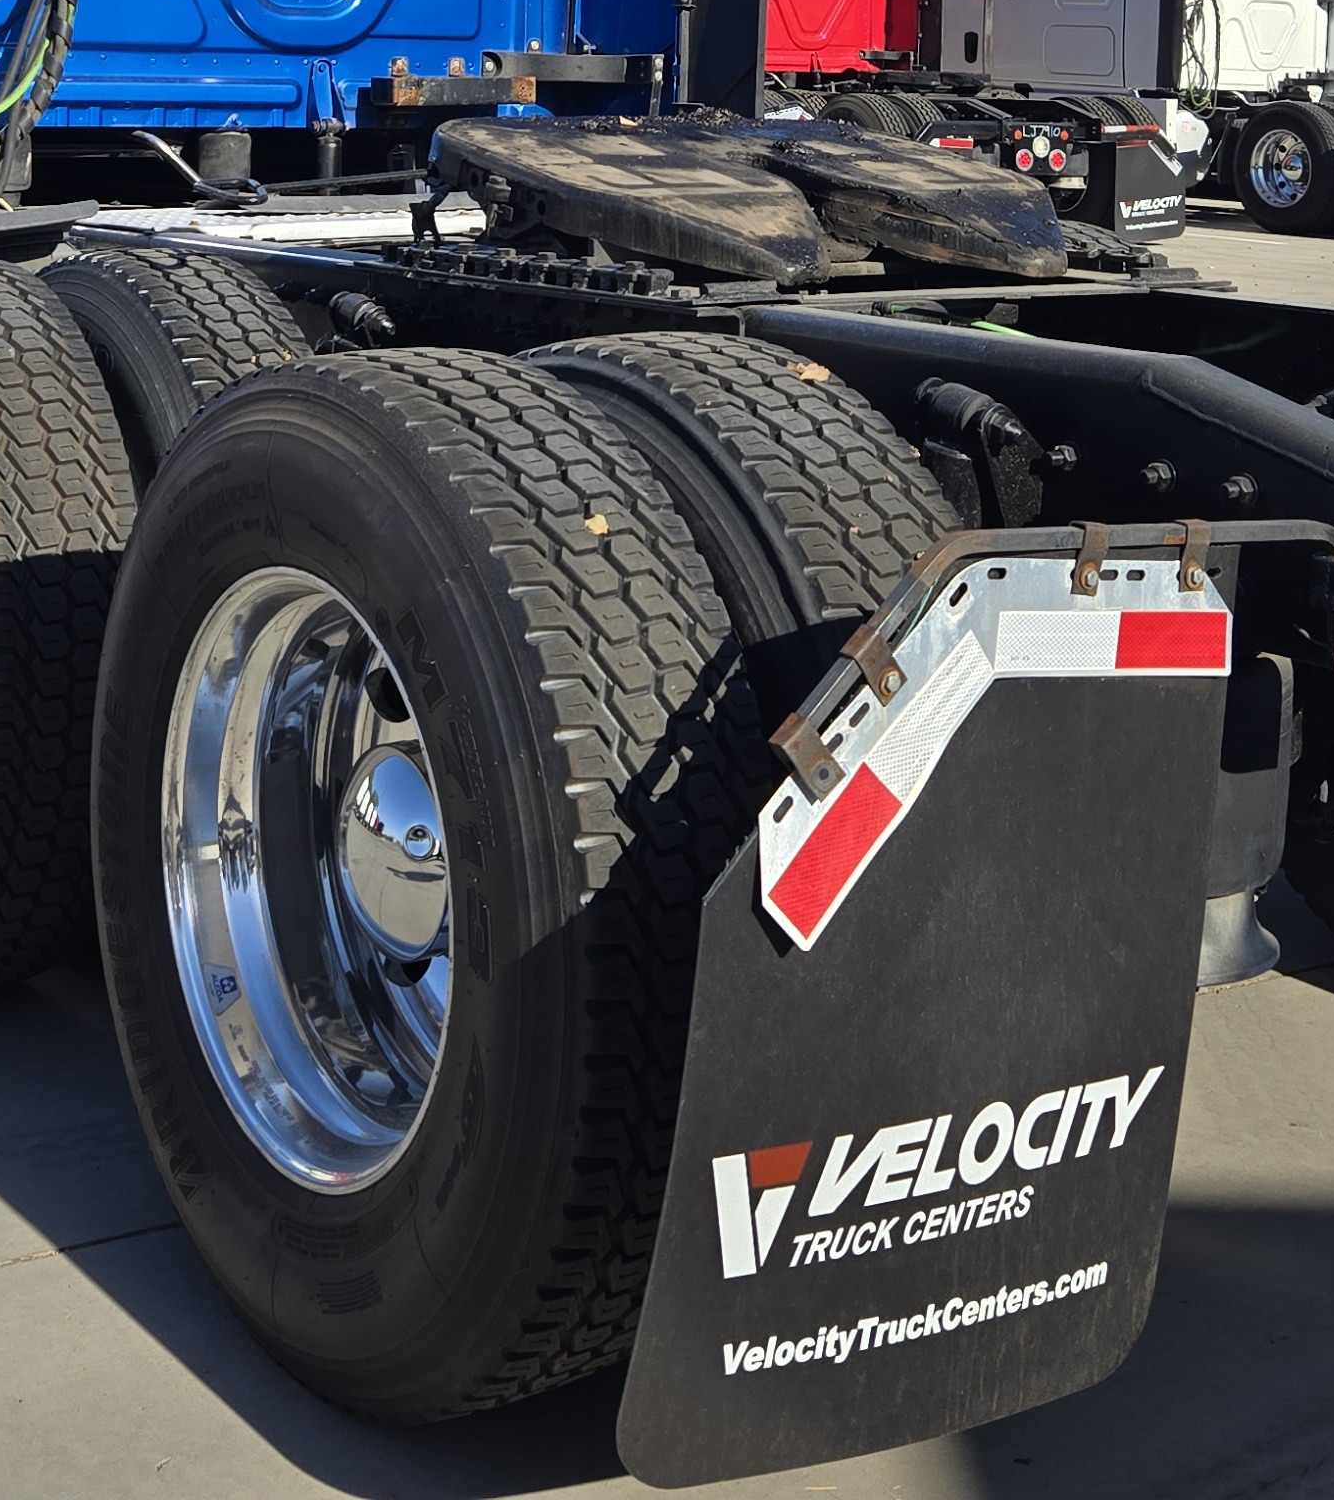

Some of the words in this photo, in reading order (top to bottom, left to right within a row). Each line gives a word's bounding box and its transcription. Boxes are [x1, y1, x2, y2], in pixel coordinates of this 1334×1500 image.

[1022, 124, 1061, 138] LJ7910
[1132, 194, 1183, 211] VELOCITY
[807, 1065, 1165, 1217] VELOCITY
[788, 1216, 900, 1268] TRUCK
[903, 1185, 1035, 1246] CENTERS
[722, 1258, 1109, 1376] VelocityTruckCenters.com
